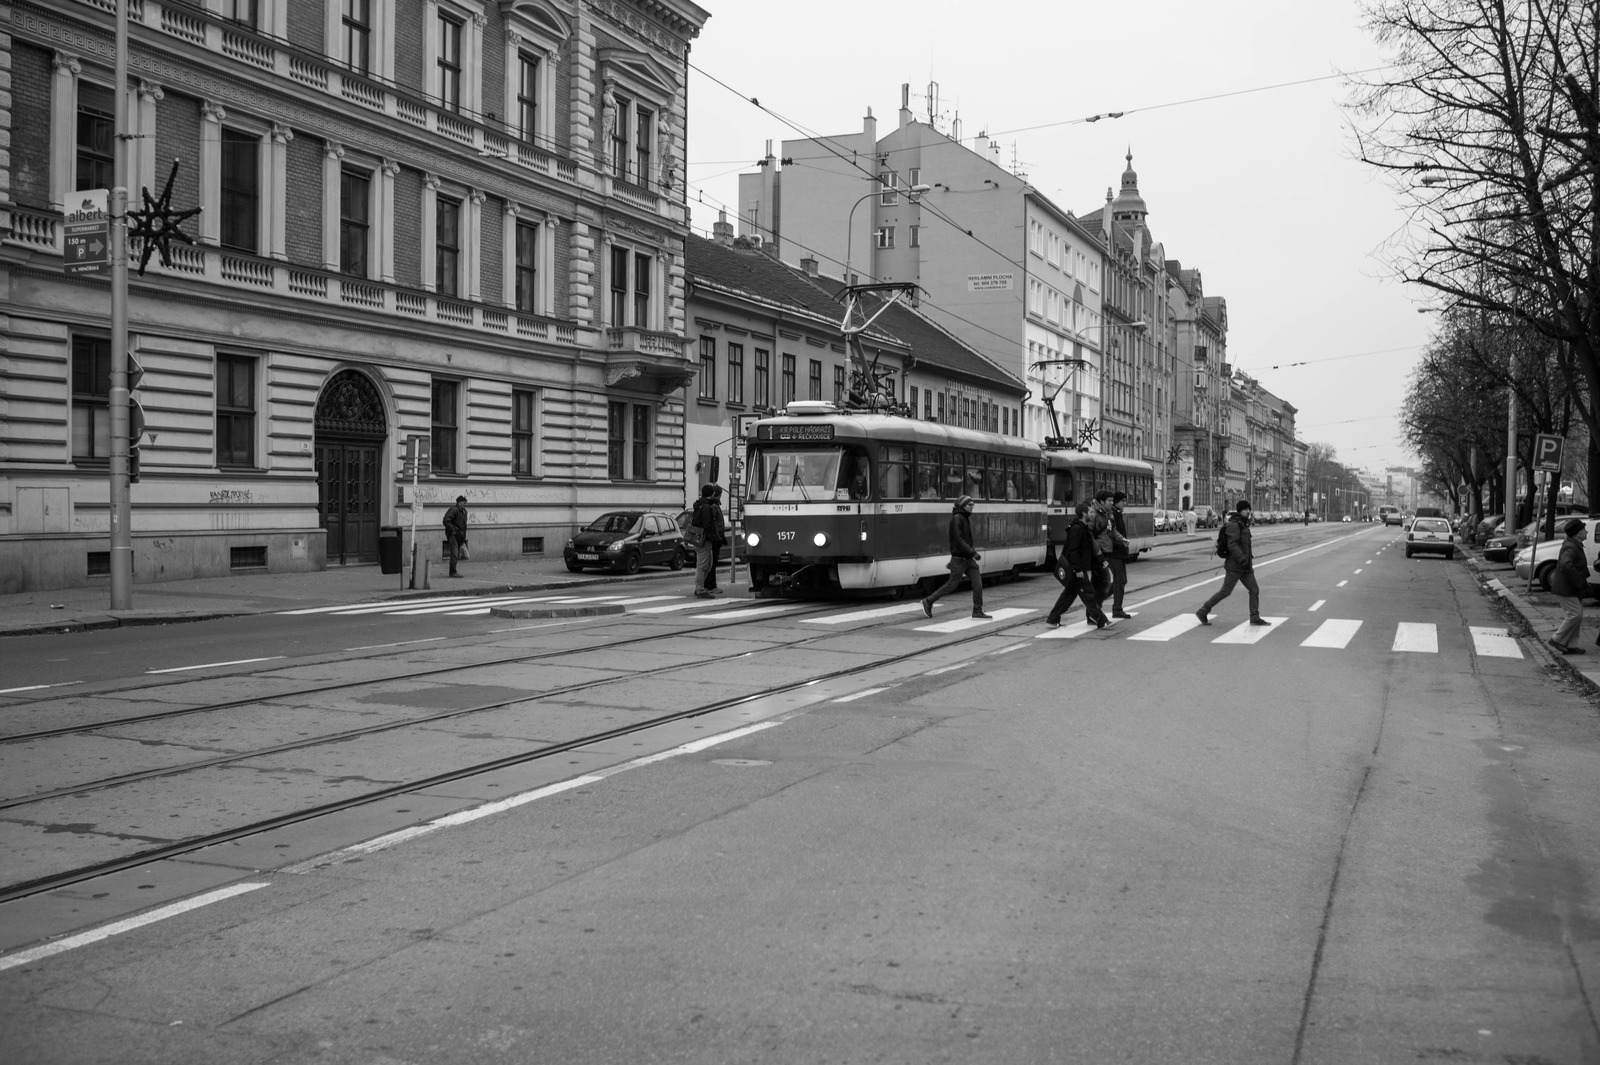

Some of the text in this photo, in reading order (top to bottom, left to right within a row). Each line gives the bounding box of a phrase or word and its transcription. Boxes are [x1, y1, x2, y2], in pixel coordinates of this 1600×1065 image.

[69, 207, 102, 222] albert
[68, 237, 79, 245] 150
[78, 248, 85, 257] P
[767, 425, 773, 440] 1
[1540, 438, 1558, 460] P
[894, 504, 904, 512] 1517
[776, 531, 796, 541] 1517
